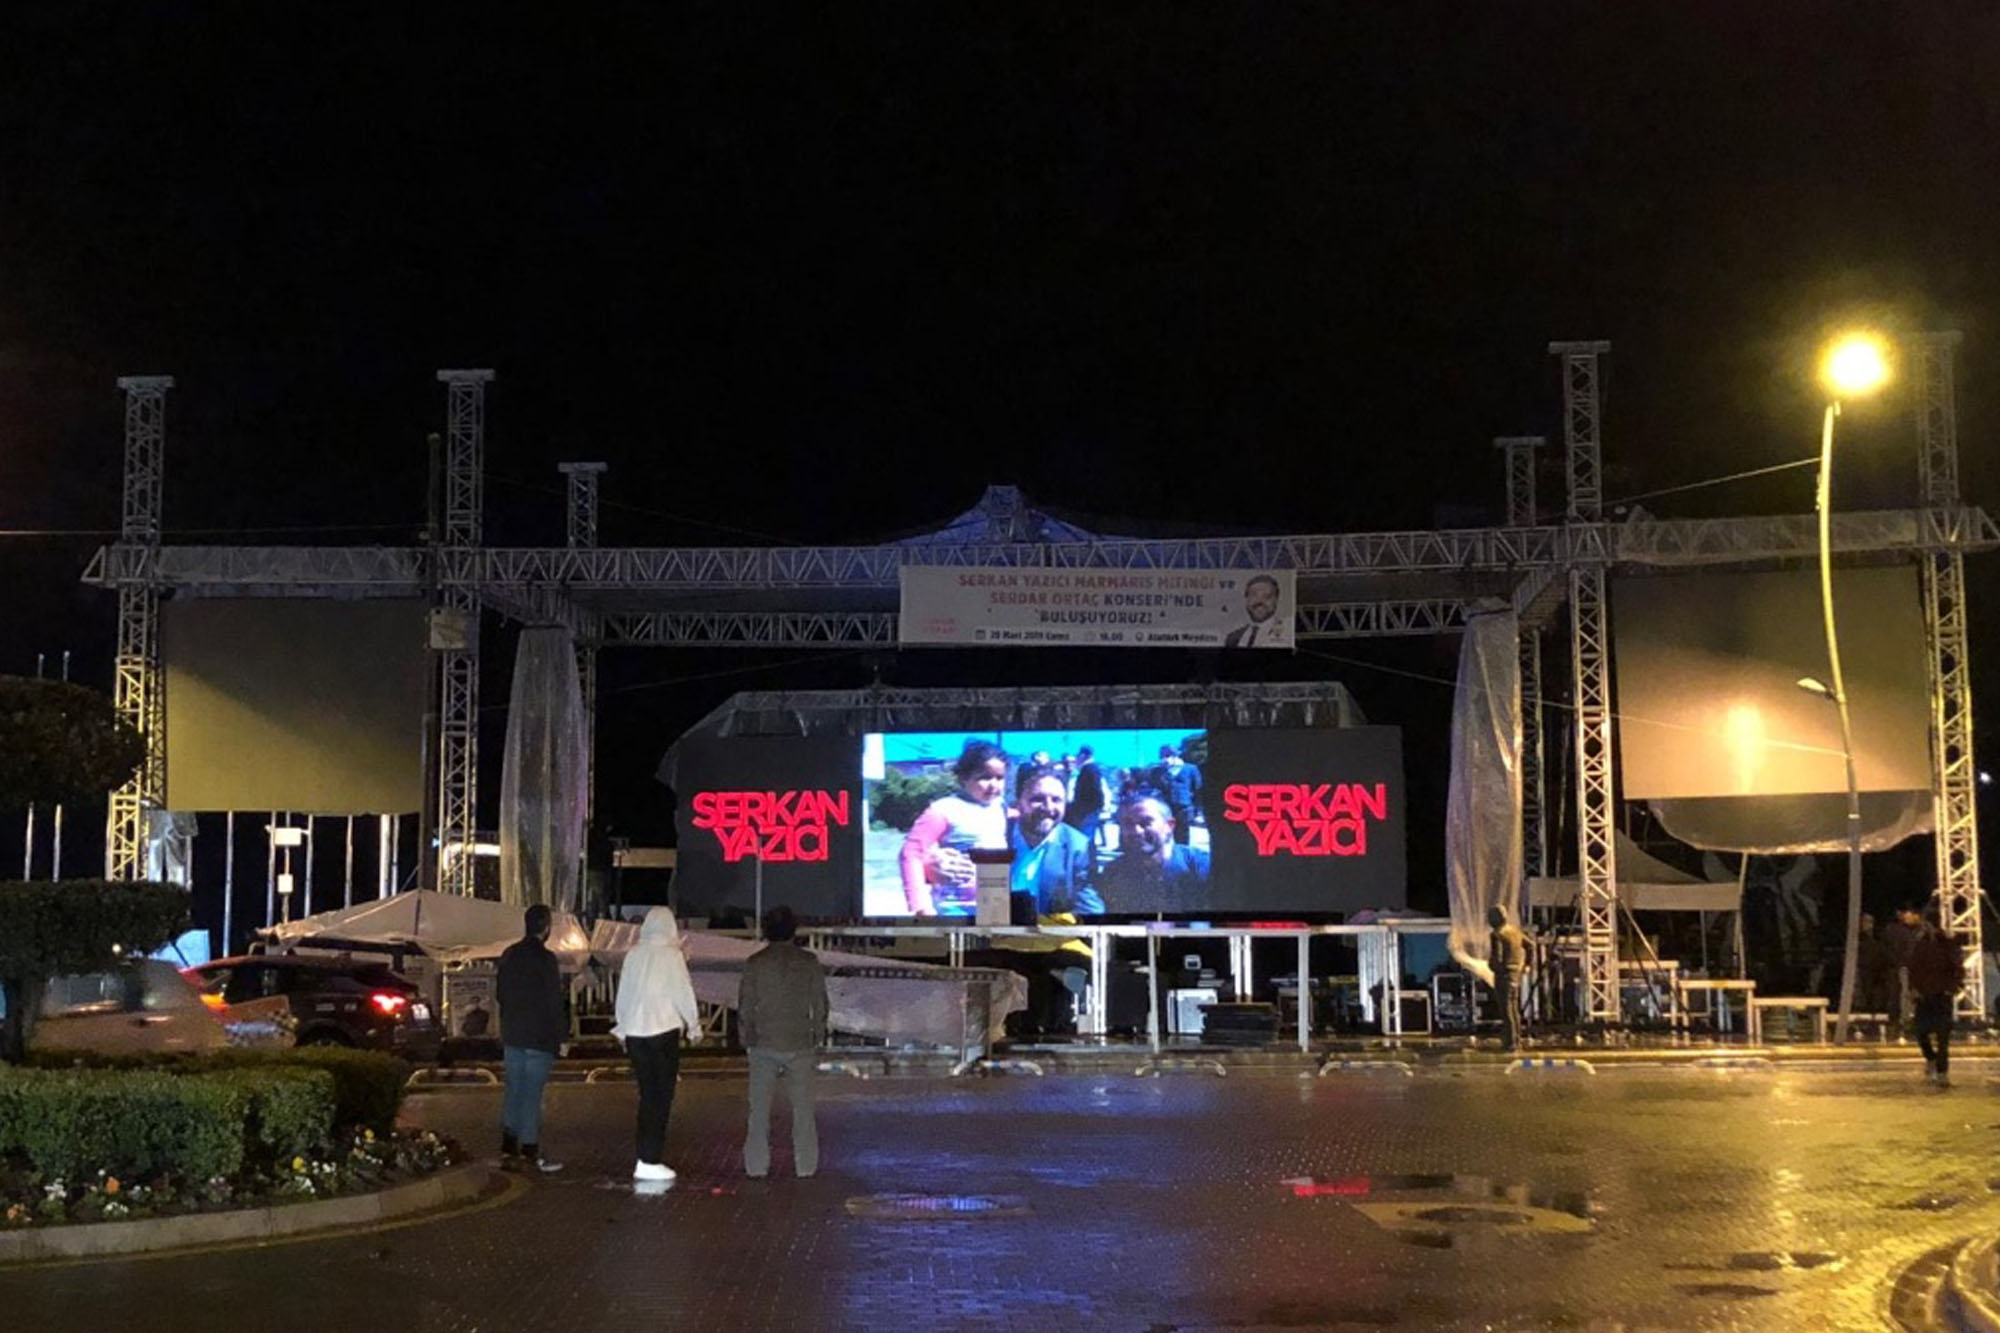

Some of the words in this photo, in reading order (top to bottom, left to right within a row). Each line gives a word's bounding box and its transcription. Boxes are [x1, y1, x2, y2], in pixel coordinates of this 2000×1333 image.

[959, 574, 1018, 587] SERKAN
[1023, 575, 1069, 588] YAZICI
[990, 592, 1048, 604] SERDAR
[1051, 592, 1098, 607] ORTAÇ
[691, 790, 850, 830] SERKAN
[1223, 783, 1387, 822] SERKAN
[713, 823, 830, 863] YAZICI
[1244, 818, 1368, 856] YAZICI
